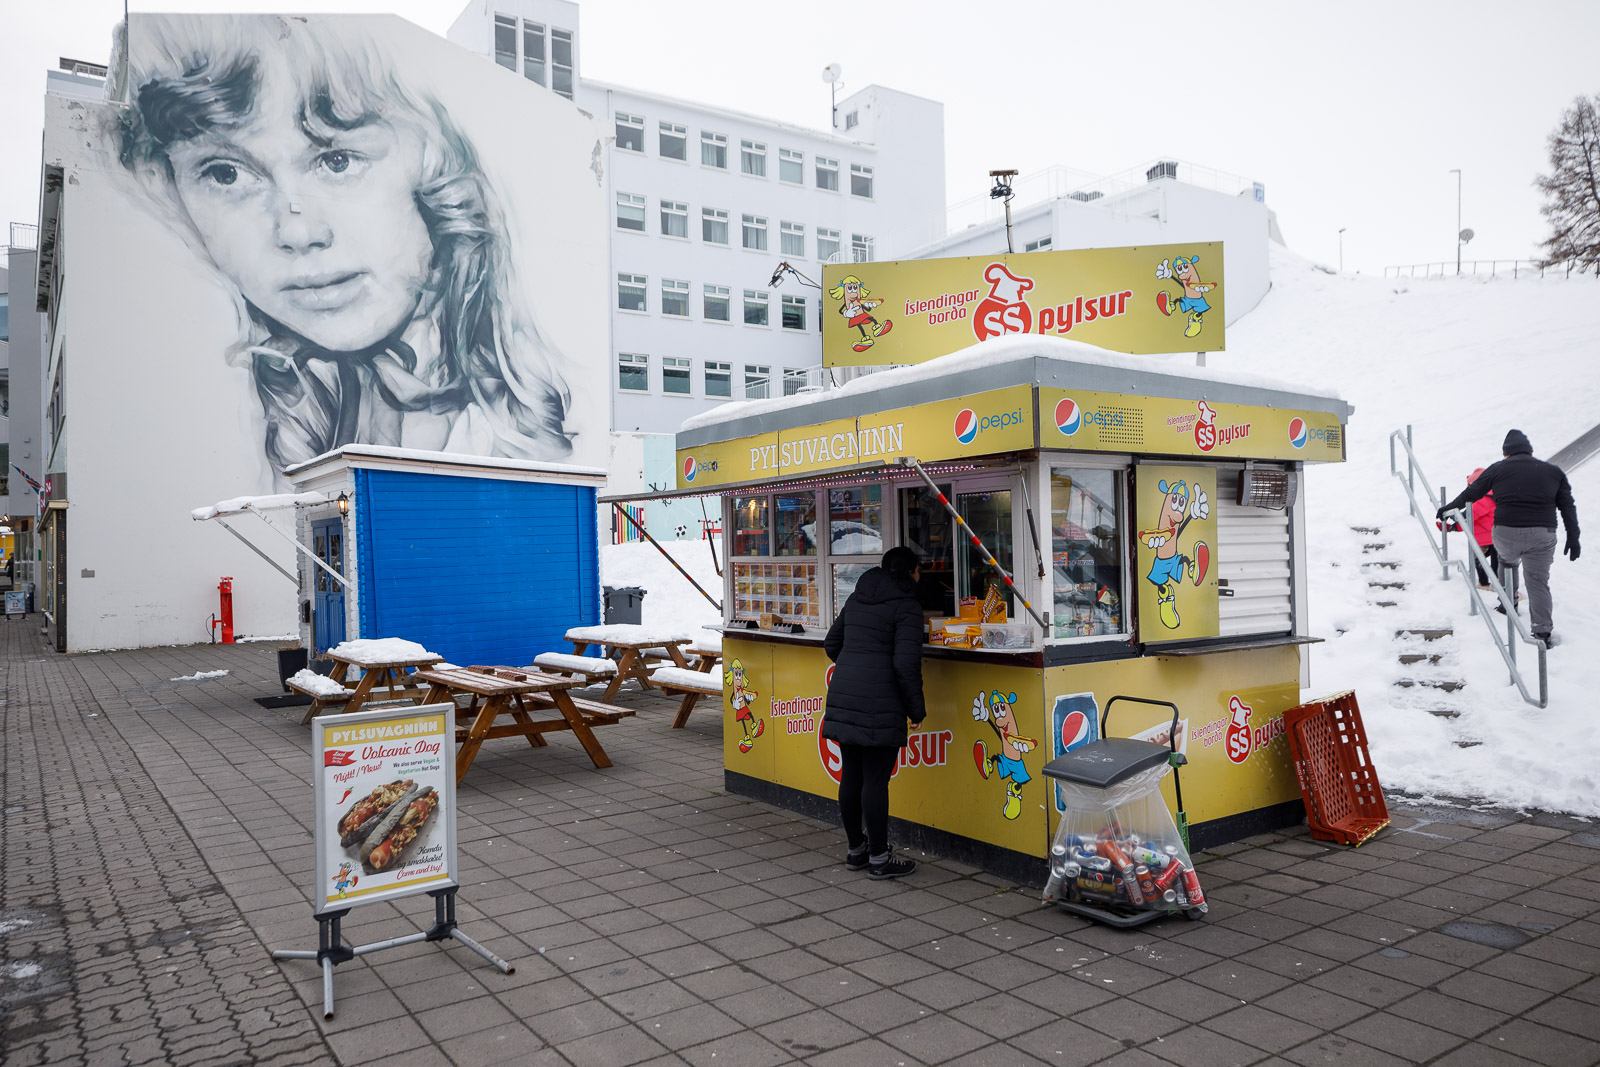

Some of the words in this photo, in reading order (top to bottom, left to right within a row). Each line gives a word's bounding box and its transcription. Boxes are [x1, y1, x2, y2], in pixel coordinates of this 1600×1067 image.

[929, 306, 967, 325] borða
[984, 305, 1024, 336] SS
[1038, 291, 1132, 336] pylsur
[980, 408, 1023, 432] pepsi
[1083, 411, 1123, 434] pepsi
[1198, 425, 1213, 447] SS
[1218, 423, 1251, 446] pylsur
[750, 423, 904, 471] PYLSUVAGNINN
[332, 721, 438, 743] PYLSUVAGNINN
[787, 714, 814, 734] borða
[362, 742, 412, 760] Volcanic
[415, 740, 440, 755] Dog
[1230, 728, 1249, 758] SS
[416, 864, 430, 874] and
